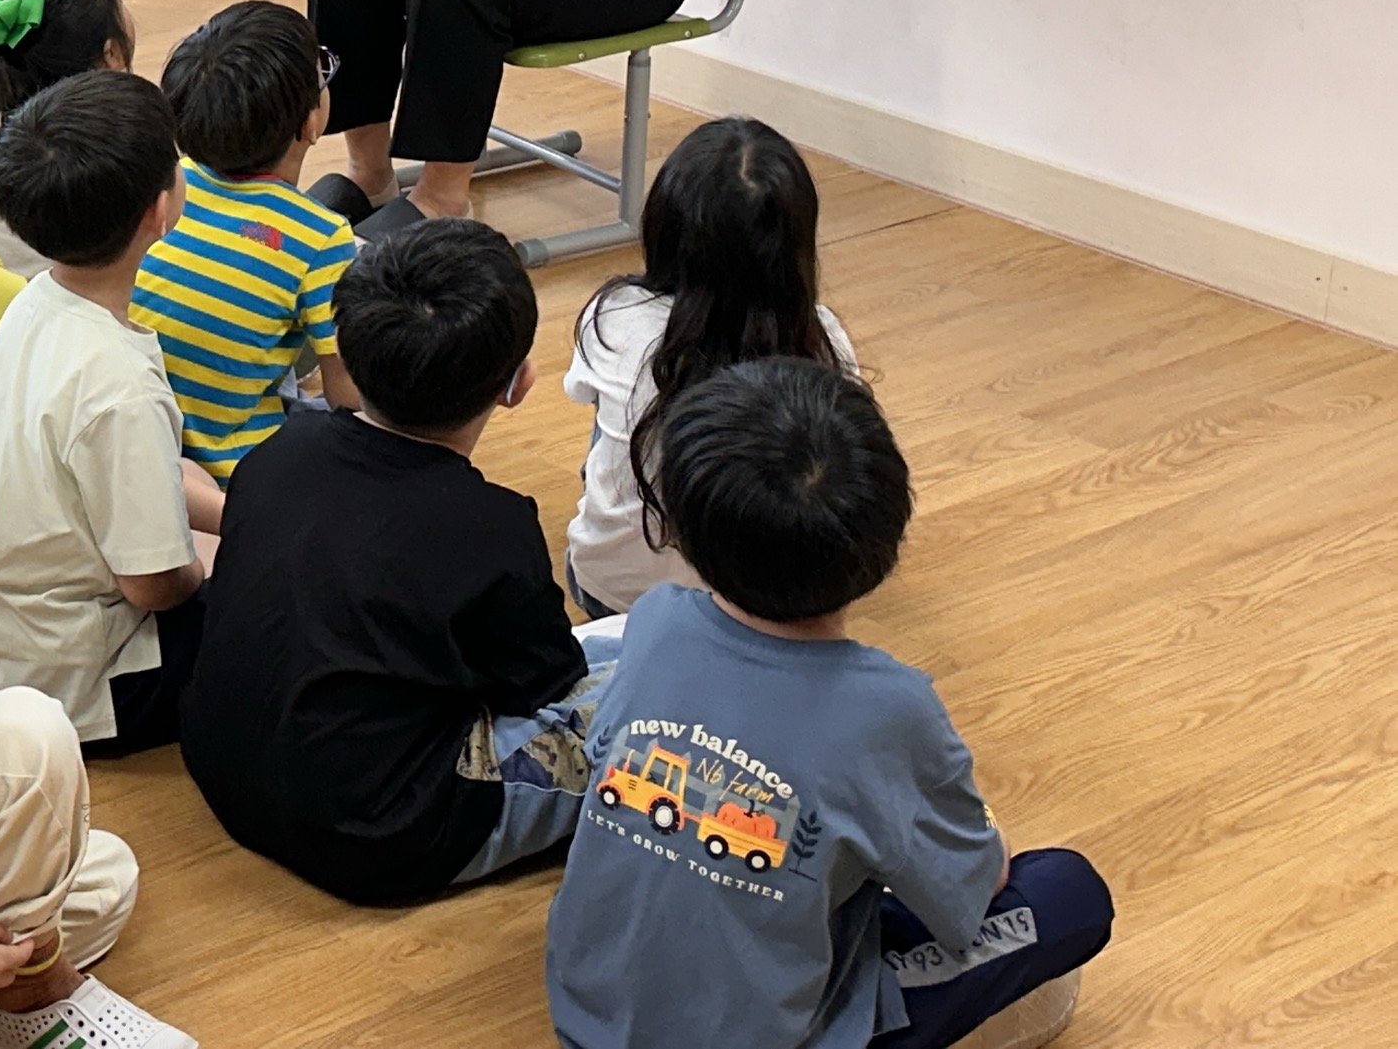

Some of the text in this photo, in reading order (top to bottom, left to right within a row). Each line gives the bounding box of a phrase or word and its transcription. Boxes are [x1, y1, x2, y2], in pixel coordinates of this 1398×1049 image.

[630, 718, 794, 800] new balance
[586, 809, 785, 902] LET'S GROW TOGETHER
